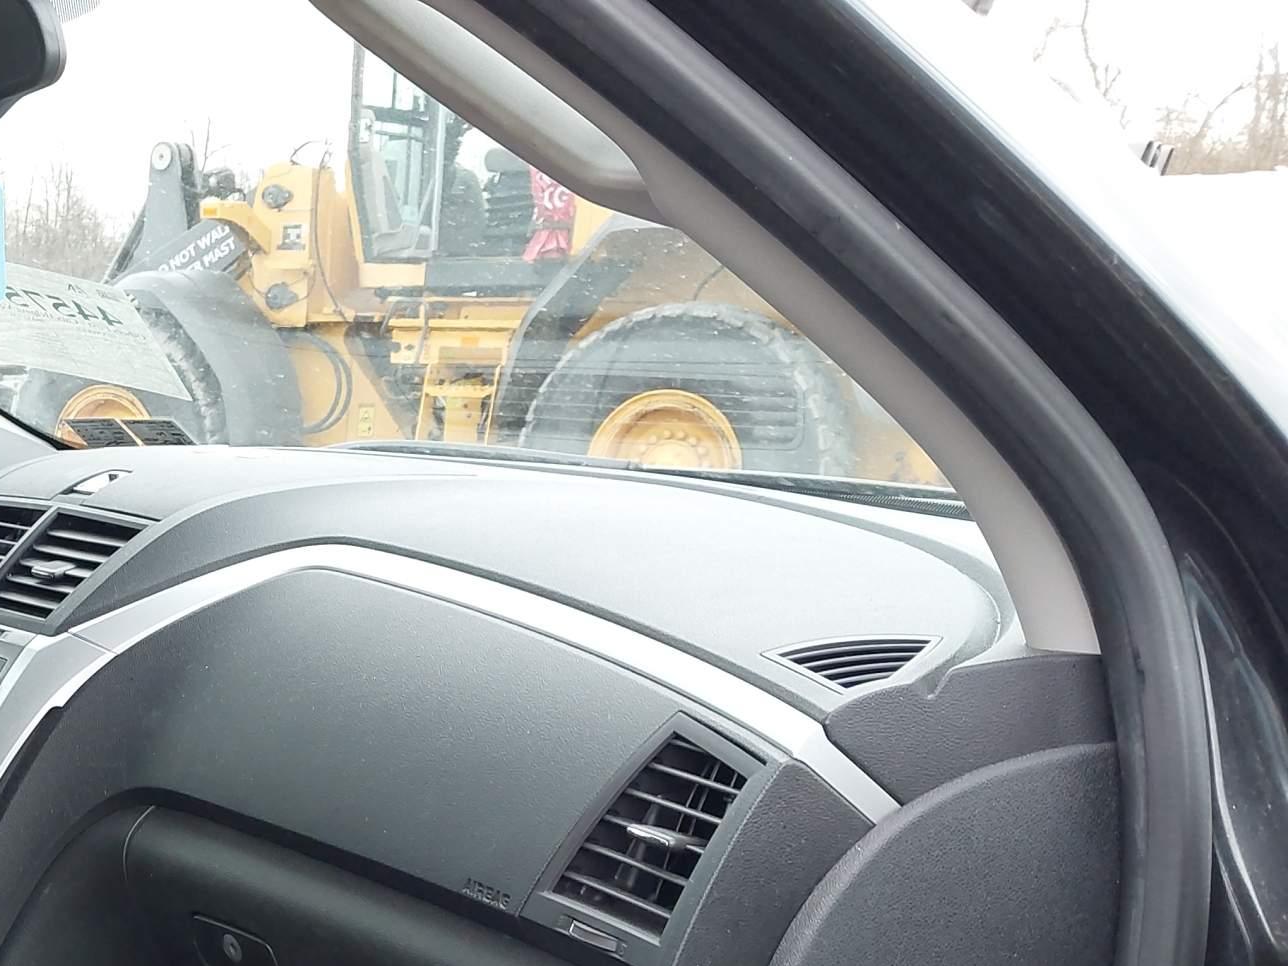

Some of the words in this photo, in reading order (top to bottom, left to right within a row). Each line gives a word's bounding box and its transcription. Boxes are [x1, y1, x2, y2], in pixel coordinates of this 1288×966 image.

[169, 243, 197, 271] NOT
[202, 236, 236, 268] MAST
[462, 877, 511, 910] AIRBAG
